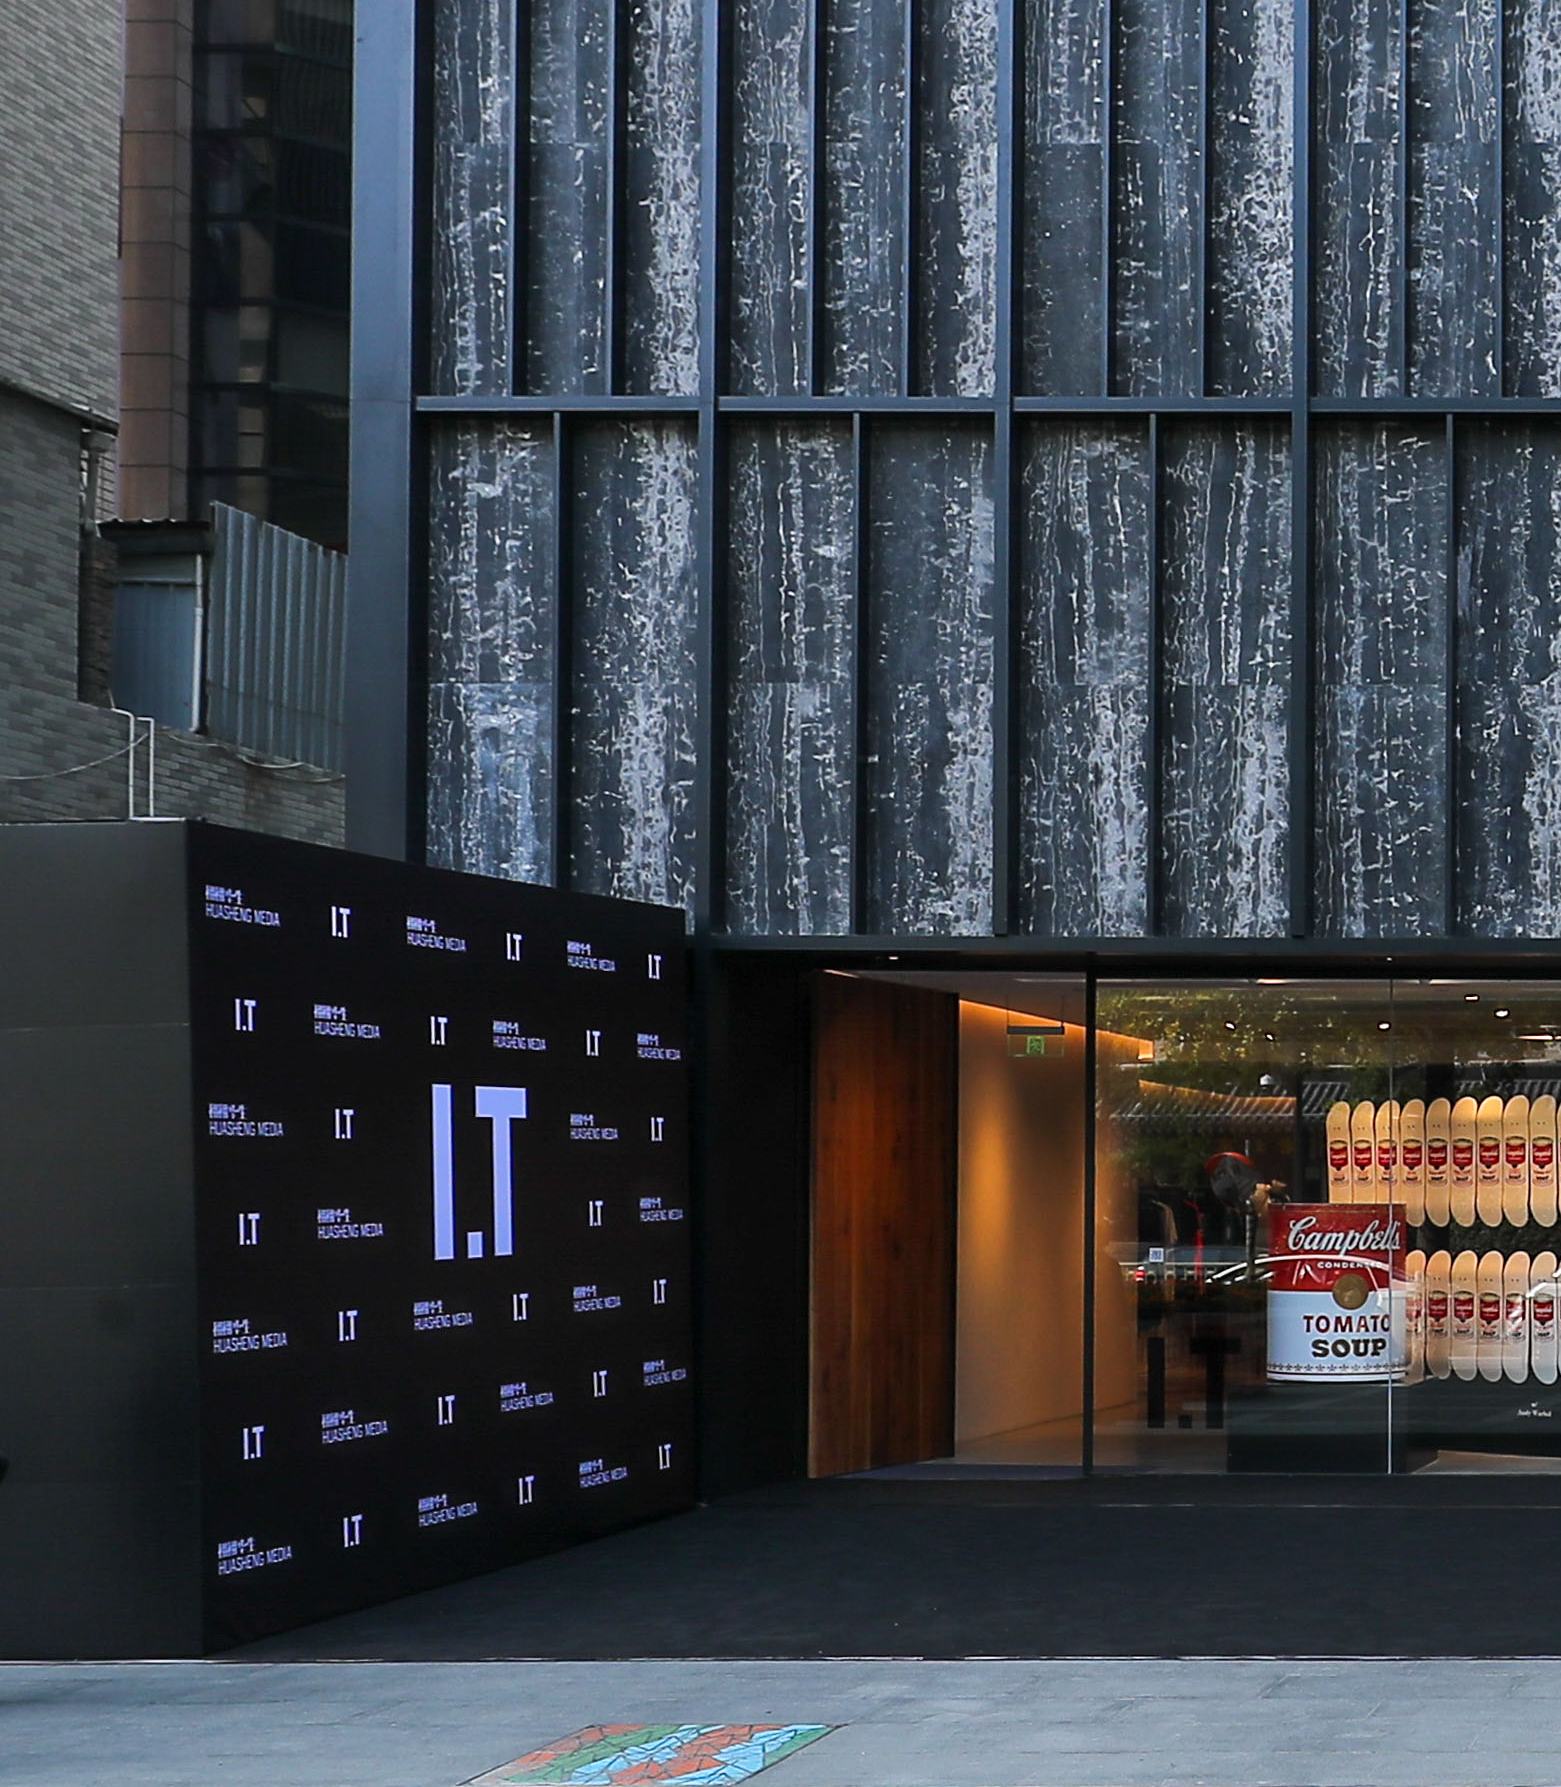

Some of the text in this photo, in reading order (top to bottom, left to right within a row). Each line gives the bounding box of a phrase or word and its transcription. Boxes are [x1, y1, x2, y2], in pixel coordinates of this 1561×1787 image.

[331, 906, 351, 938] I.T
[507, 933, 524, 961] I.T
[648, 954, 661, 979] I.T
[235, 999, 257, 1031] I.T
[431, 1016, 448, 1045] I.T
[587, 1030, 601, 1056] I.T
[335, 1109, 355, 1139] I.T
[651, 1117, 664, 1141] I.T
[431, 1084, 528, 1261] I.T
[589, 1200, 603, 1226] I.T
[239, 1213, 260, 1245] I.T
[654, 1279, 667, 1304] I.T
[513, 1293, 529, 1321] I.T
[339, 1310, 358, 1341] I.T
[1311, 1338, 1386, 1358] SOUP
[593, 1370, 607, 1397] I.T
[438, 1395, 456, 1425] I.T
[243, 1425, 265, 1460] I.T
[659, 1444, 671, 1469] I.T
[519, 1475, 534, 1504] I.T
[343, 1514, 363, 1547] I.T
